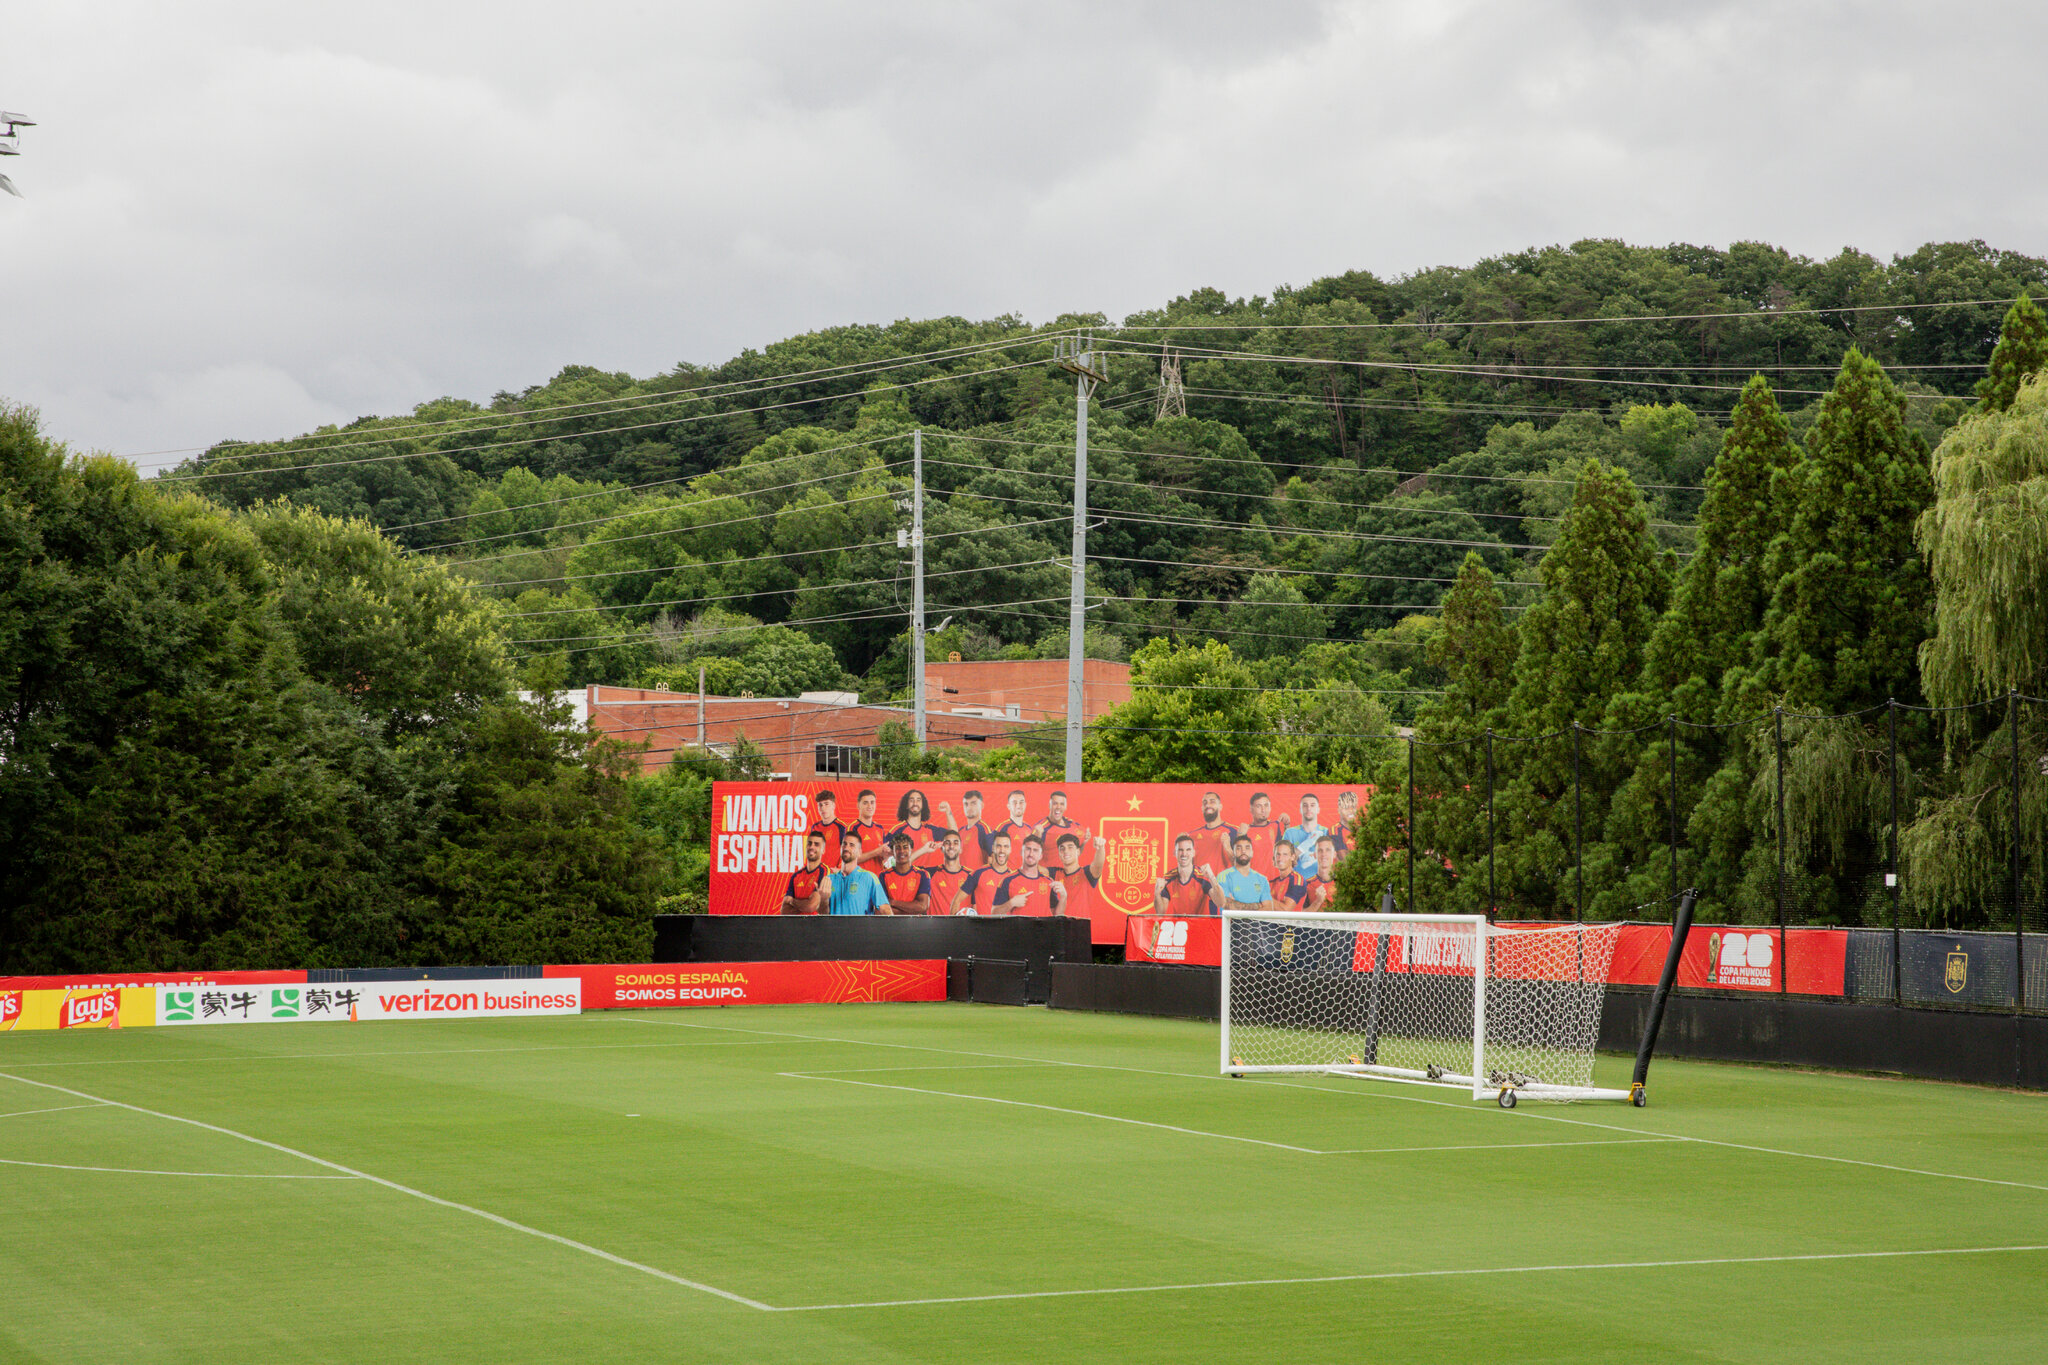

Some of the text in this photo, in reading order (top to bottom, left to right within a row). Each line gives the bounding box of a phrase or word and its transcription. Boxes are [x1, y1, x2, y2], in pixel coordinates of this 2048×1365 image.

[1157, 921, 1188, 946] 26
[1720, 932, 1774, 968] 26
[615, 969, 749, 986] SOMOS ESPAÑA,
[1719, 975, 1771, 987] DE LA FIFA 2026
[1720, 966, 1772, 978] COPA MUNDIAL
[201, 991, 257, 1018] 蒙牛
[305, 989, 360, 1015] 蒙牛
[379, 988, 577, 1012] verizon business
[615, 987, 747, 1001] SOMOS EQUIPO.
[68, 991, 115, 1025] Lay's
